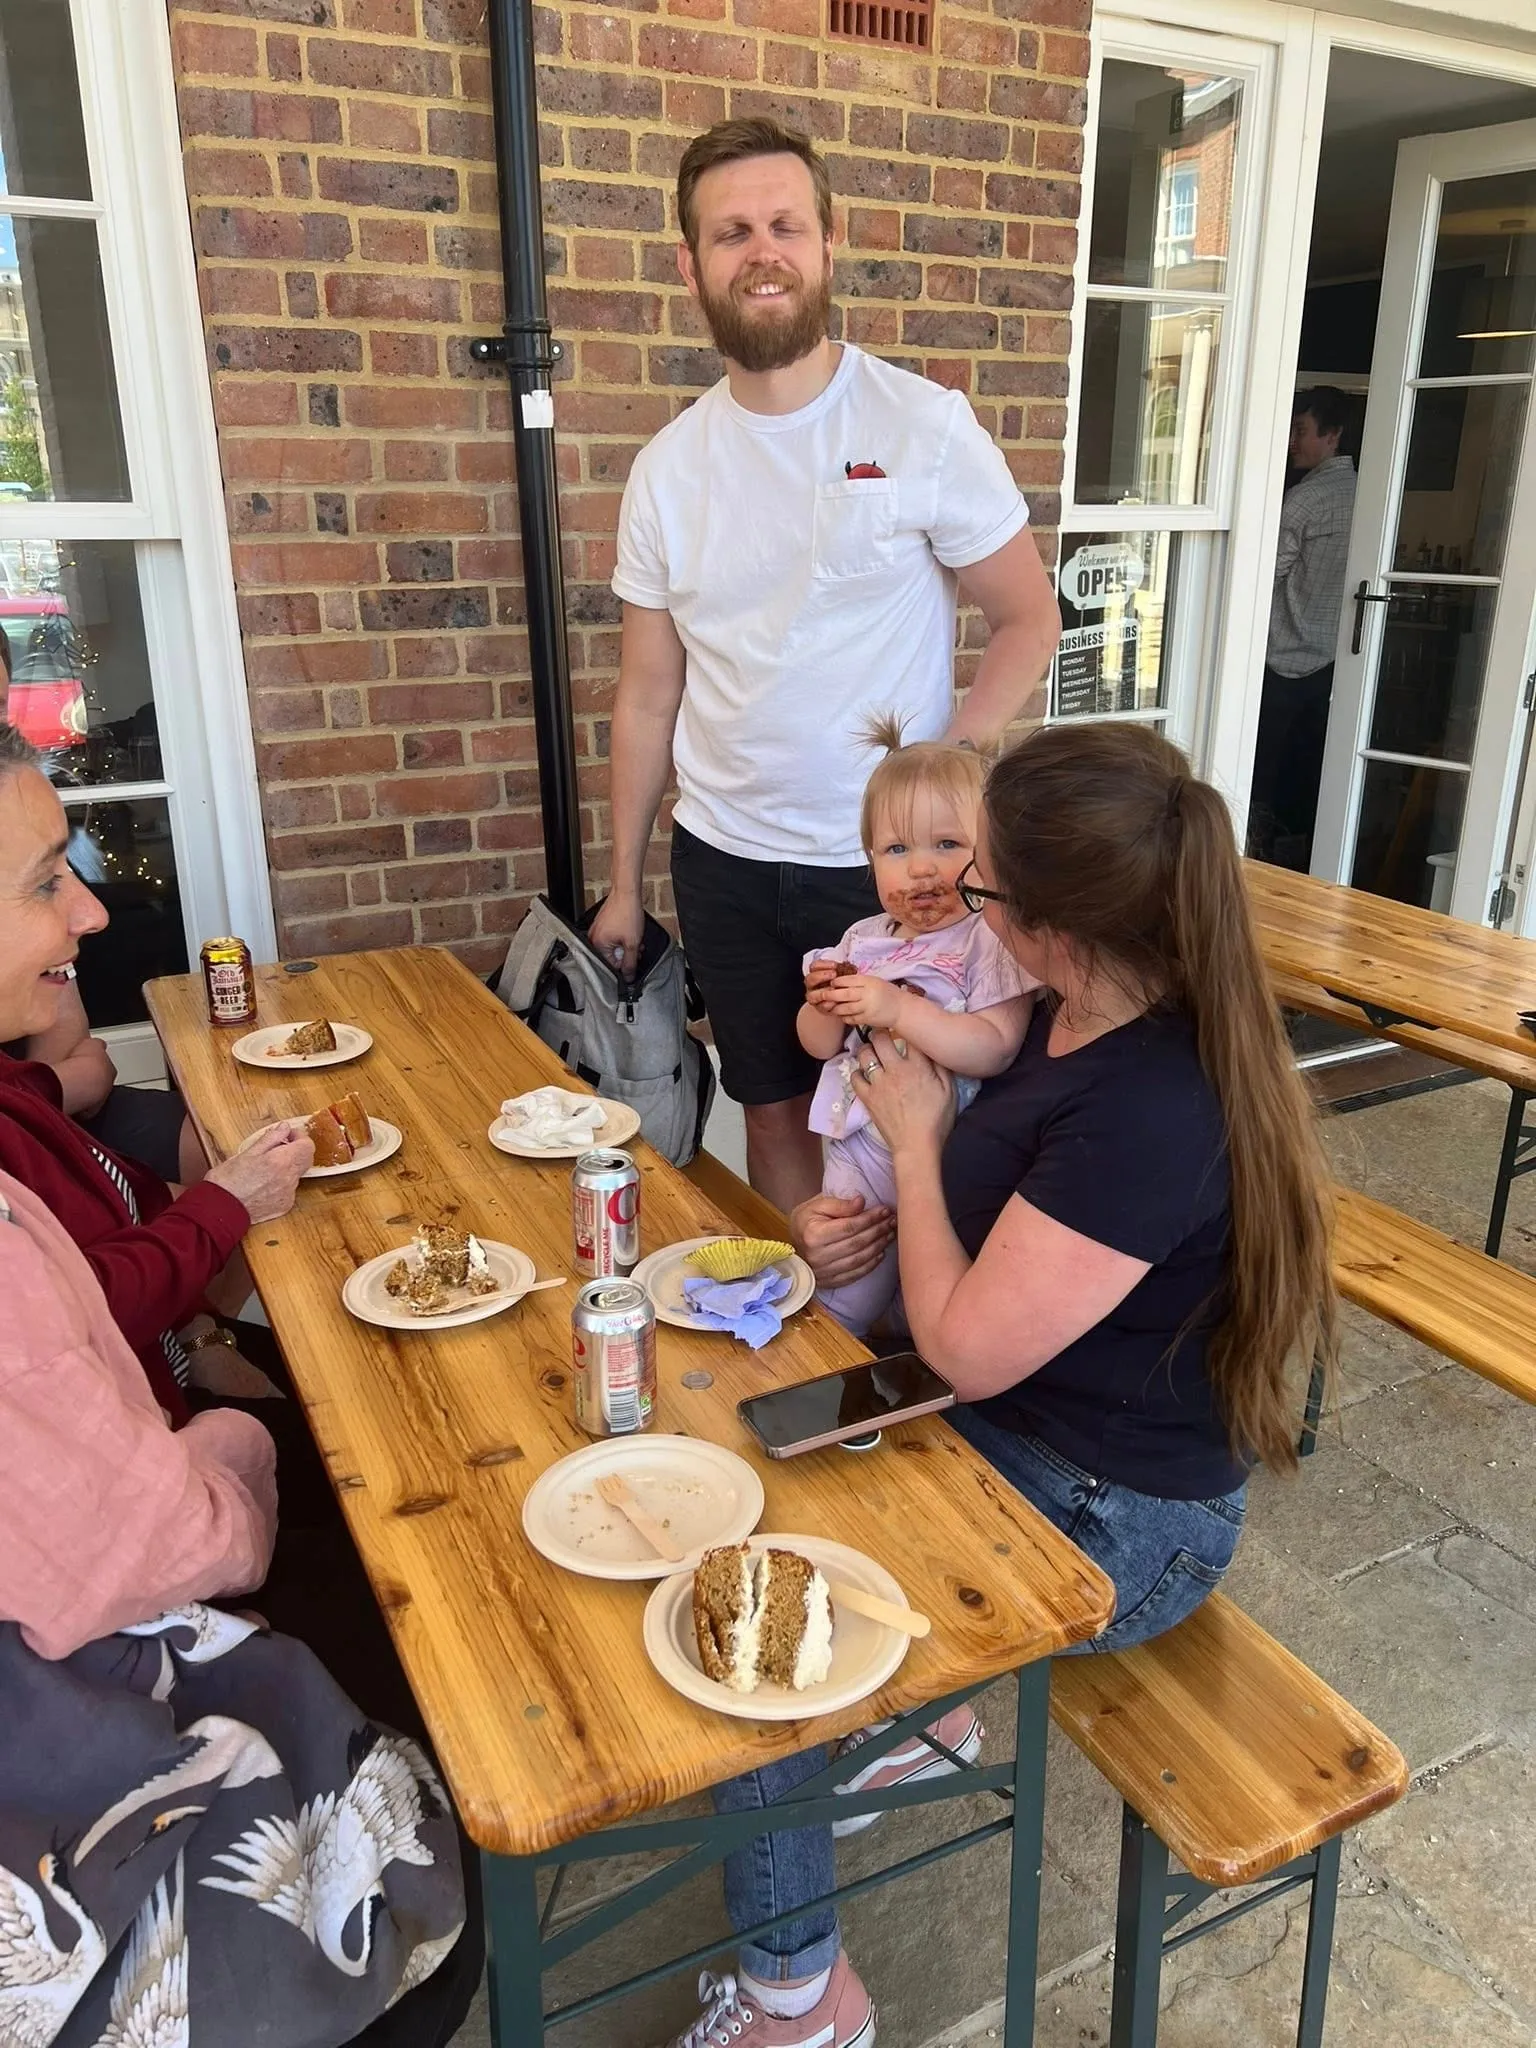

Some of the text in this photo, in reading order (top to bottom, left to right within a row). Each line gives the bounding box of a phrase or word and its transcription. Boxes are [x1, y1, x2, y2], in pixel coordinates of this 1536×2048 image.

[1077, 566, 1127, 597] OPEN
[1059, 631, 1104, 651] BUSINESS
[1062, 656, 1086, 666] MONDAY
[1062, 667, 1087, 677] TUESDAY
[1062, 677, 1095, 688] WEDNESDAY
[1062, 688, 1091, 699] THURSDAY
[1061, 701, 1081, 710] FRIDAY
[220, 996, 239, 1005] BEER
